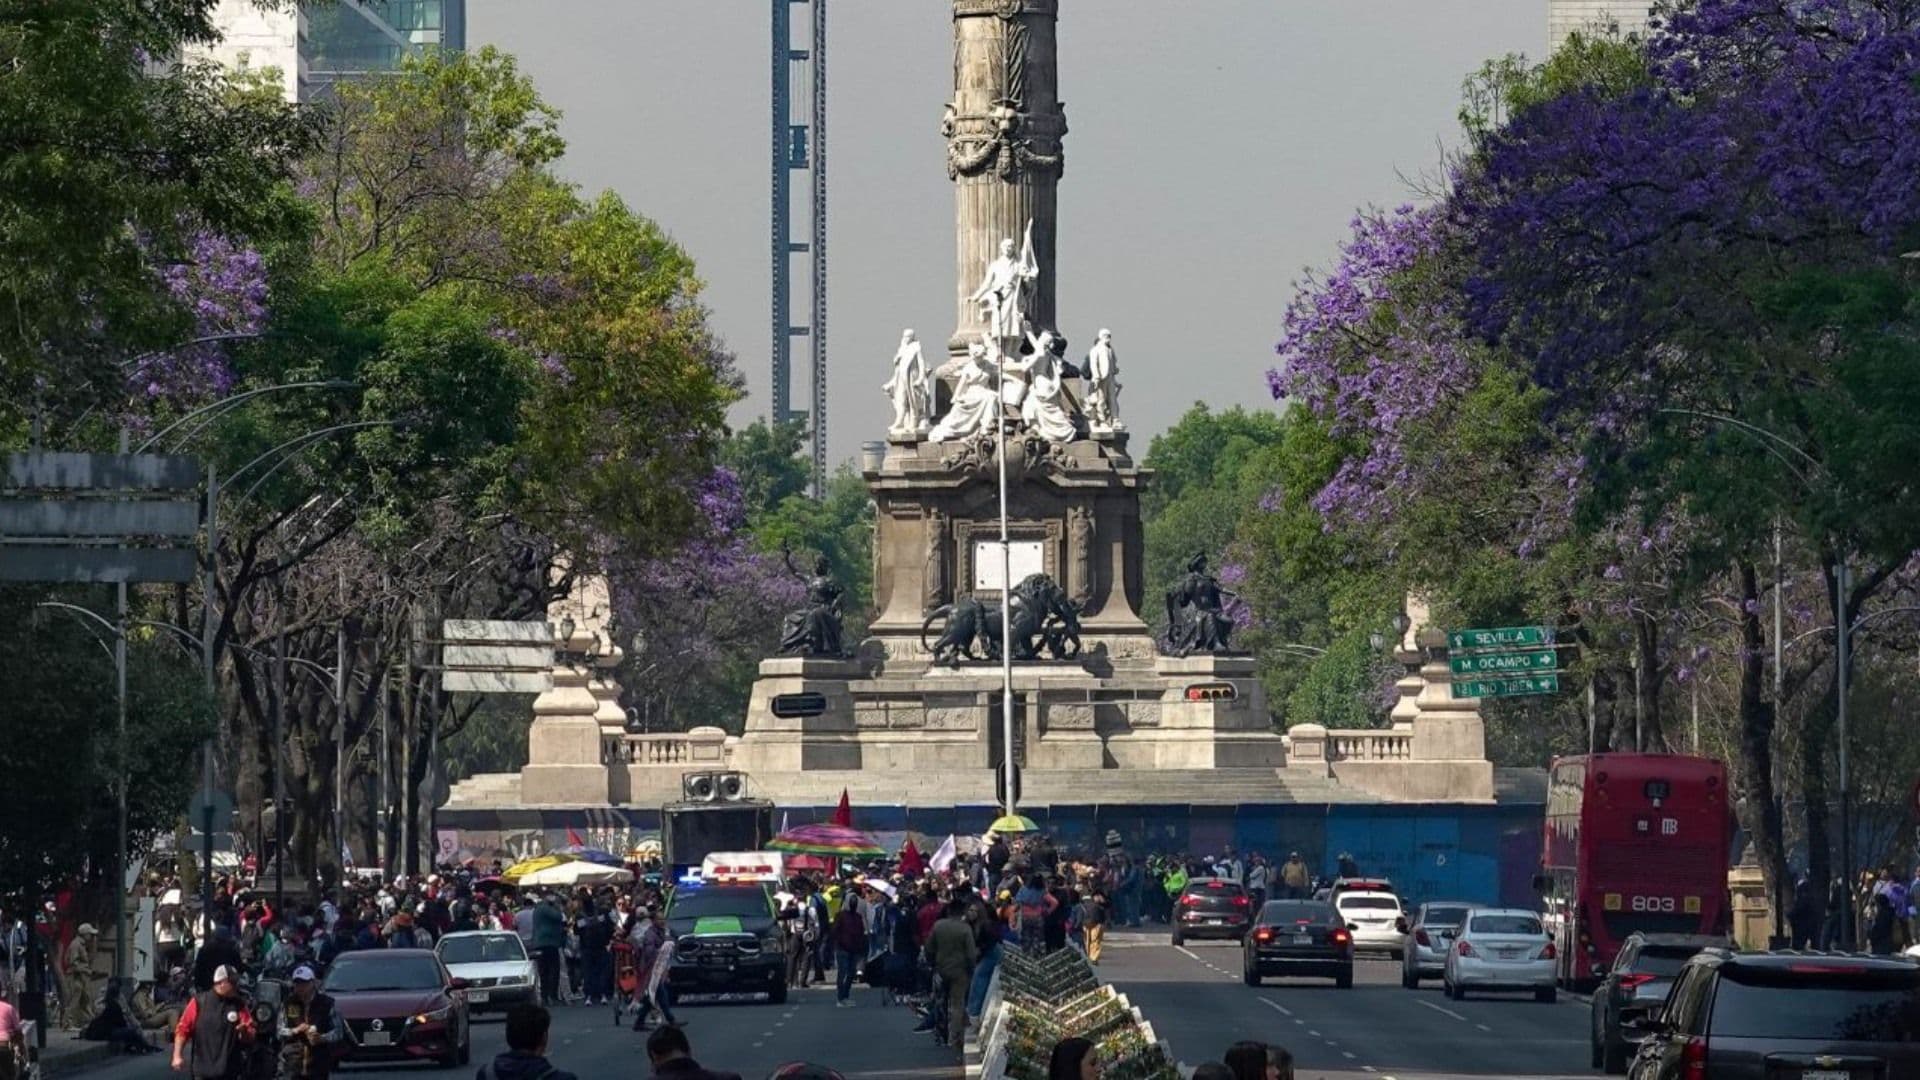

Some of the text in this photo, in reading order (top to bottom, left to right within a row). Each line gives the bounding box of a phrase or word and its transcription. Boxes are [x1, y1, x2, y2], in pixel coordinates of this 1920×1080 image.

[1475, 631, 1526, 645] SEVILLA
[1479, 656, 1531, 669] OCAMPO
[1632, 896, 1675, 911] 803
